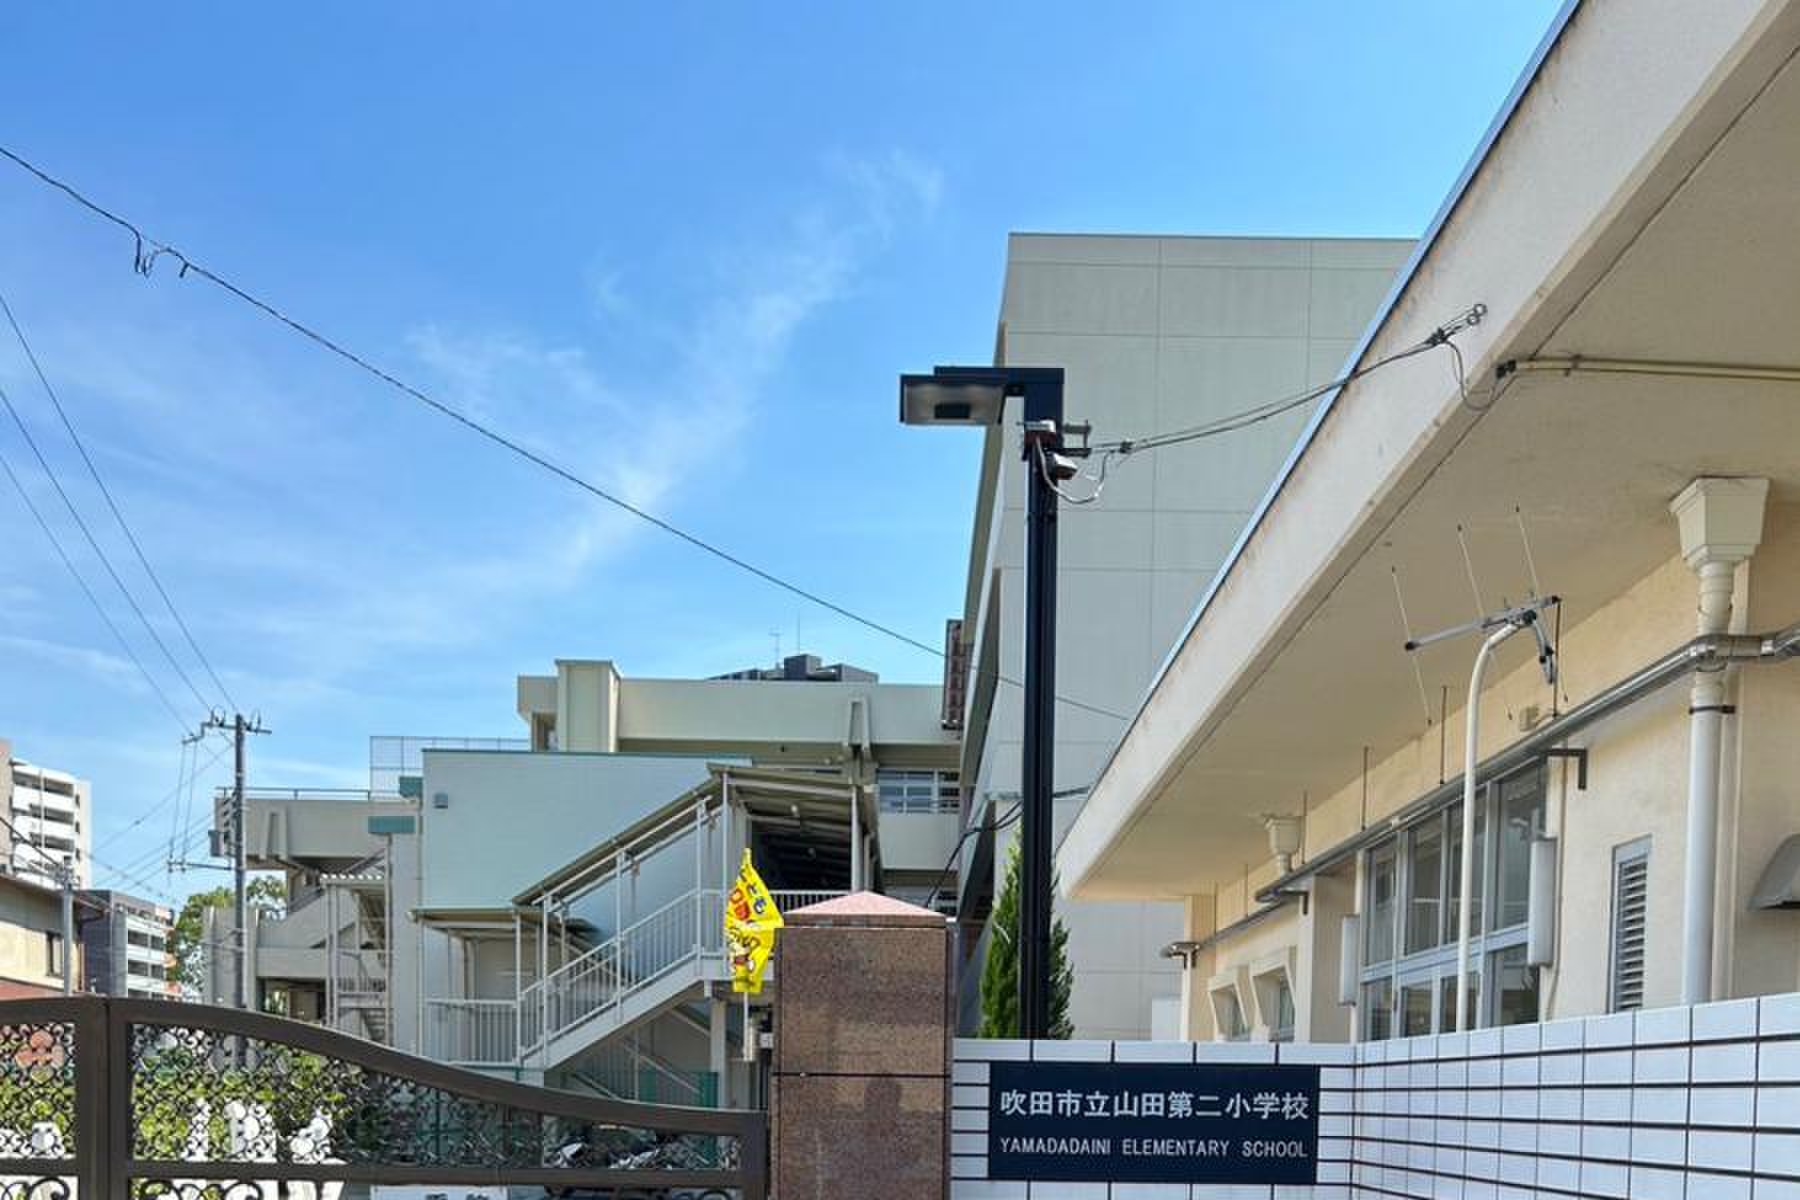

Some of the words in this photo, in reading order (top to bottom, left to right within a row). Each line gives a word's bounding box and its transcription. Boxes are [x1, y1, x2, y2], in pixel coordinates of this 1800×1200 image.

[1000, 1089, 1309, 1119] 吹田市立山田第二小学校
[1001, 1137, 1111, 1154] YAMADADAINI
[1122, 1138, 1230, 1157] ELEMENTARY
[1242, 1140, 1308, 1157] SCHOOL
